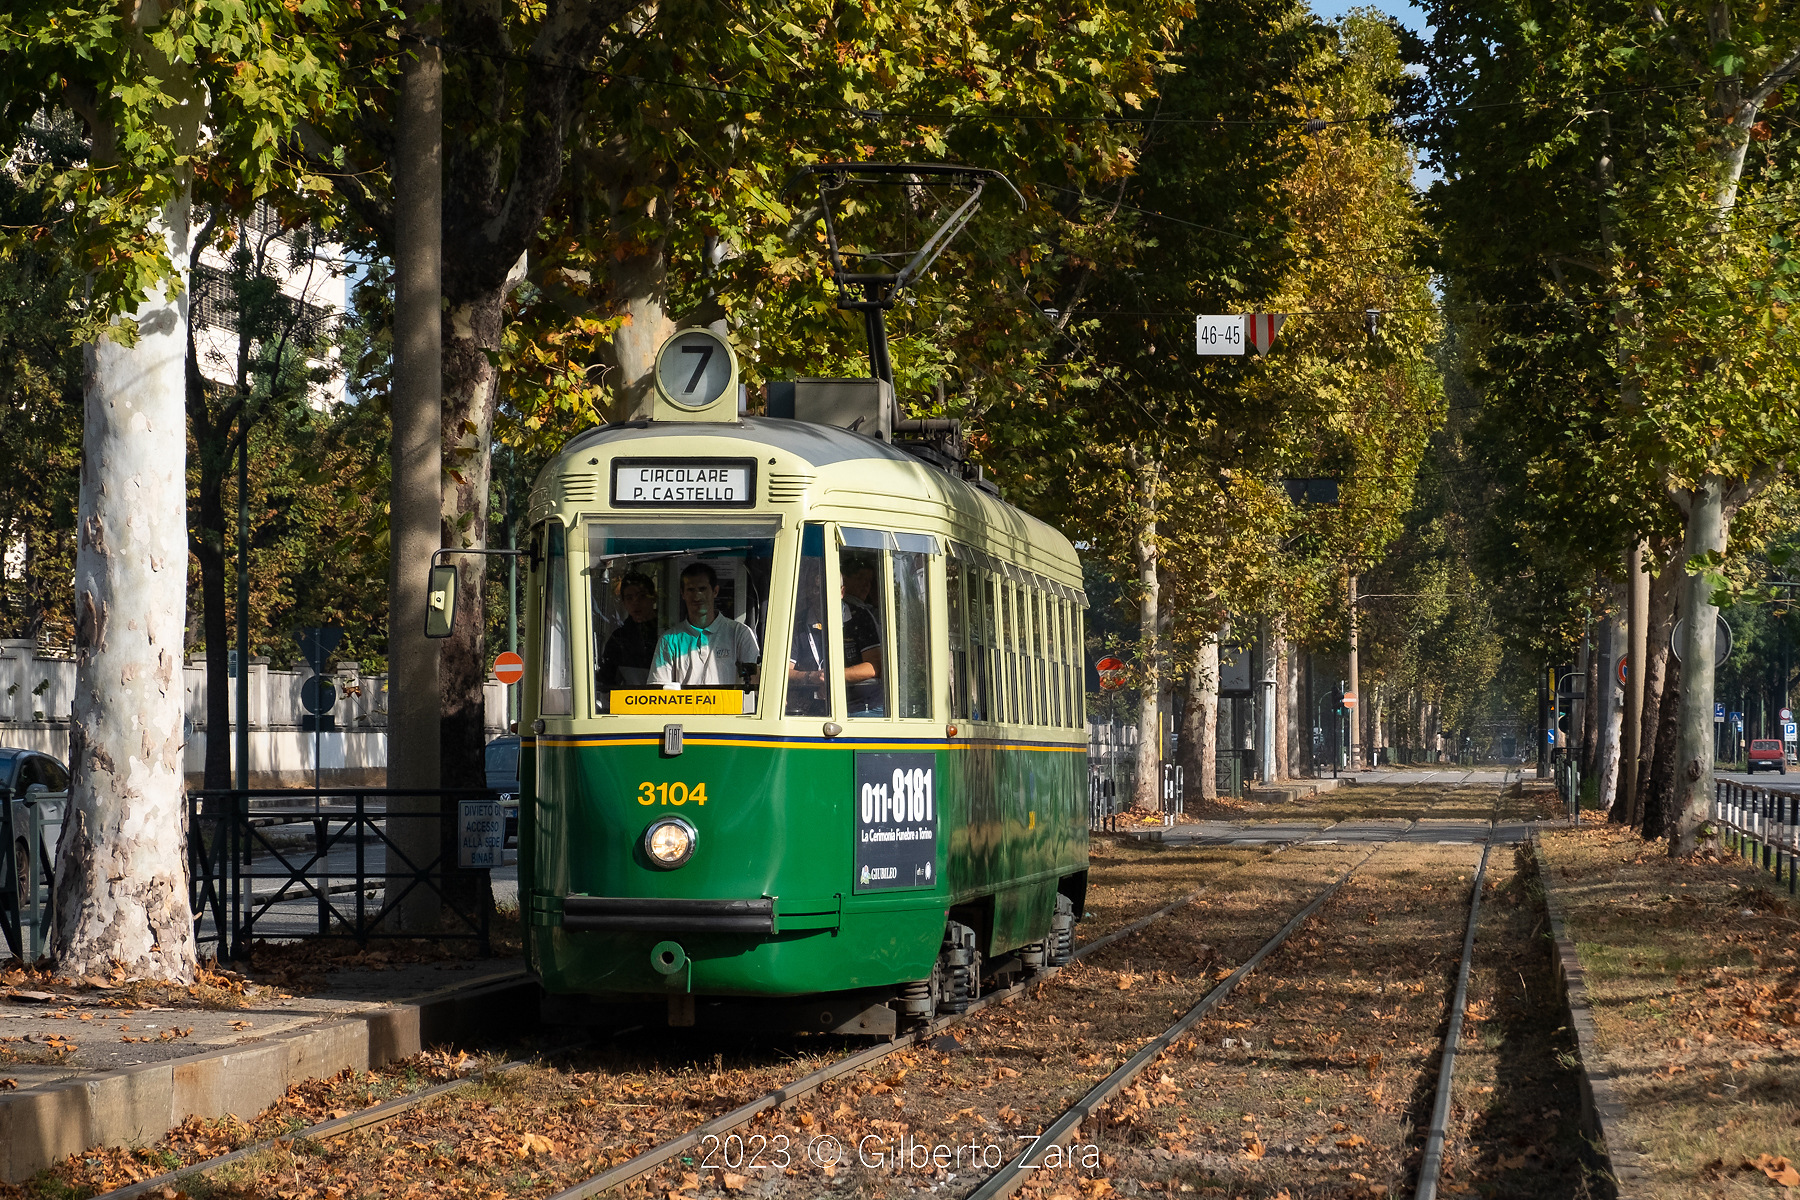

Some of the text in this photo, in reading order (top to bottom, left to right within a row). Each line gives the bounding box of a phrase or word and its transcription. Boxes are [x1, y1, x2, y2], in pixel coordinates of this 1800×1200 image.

[1201, 325, 1240, 345] 46-45
[681, 345, 714, 395] 7
[640, 469, 729, 482] CIRCOLARE
[633, 487, 734, 500] P. CASTELLO
[624, 694, 716, 706] GIORNATE FAI
[667, 728, 681, 751] FIAT
[637, 781, 708, 806] 3104
[861, 768, 933, 824] 011-8181
[464, 806, 493, 816] DIVIETO
[466, 821, 499, 833] ACCESSO
[861, 826, 933, 843] La Cerimonia Funebre a Torino
[463, 836, 500, 848] ALLA SEDE
